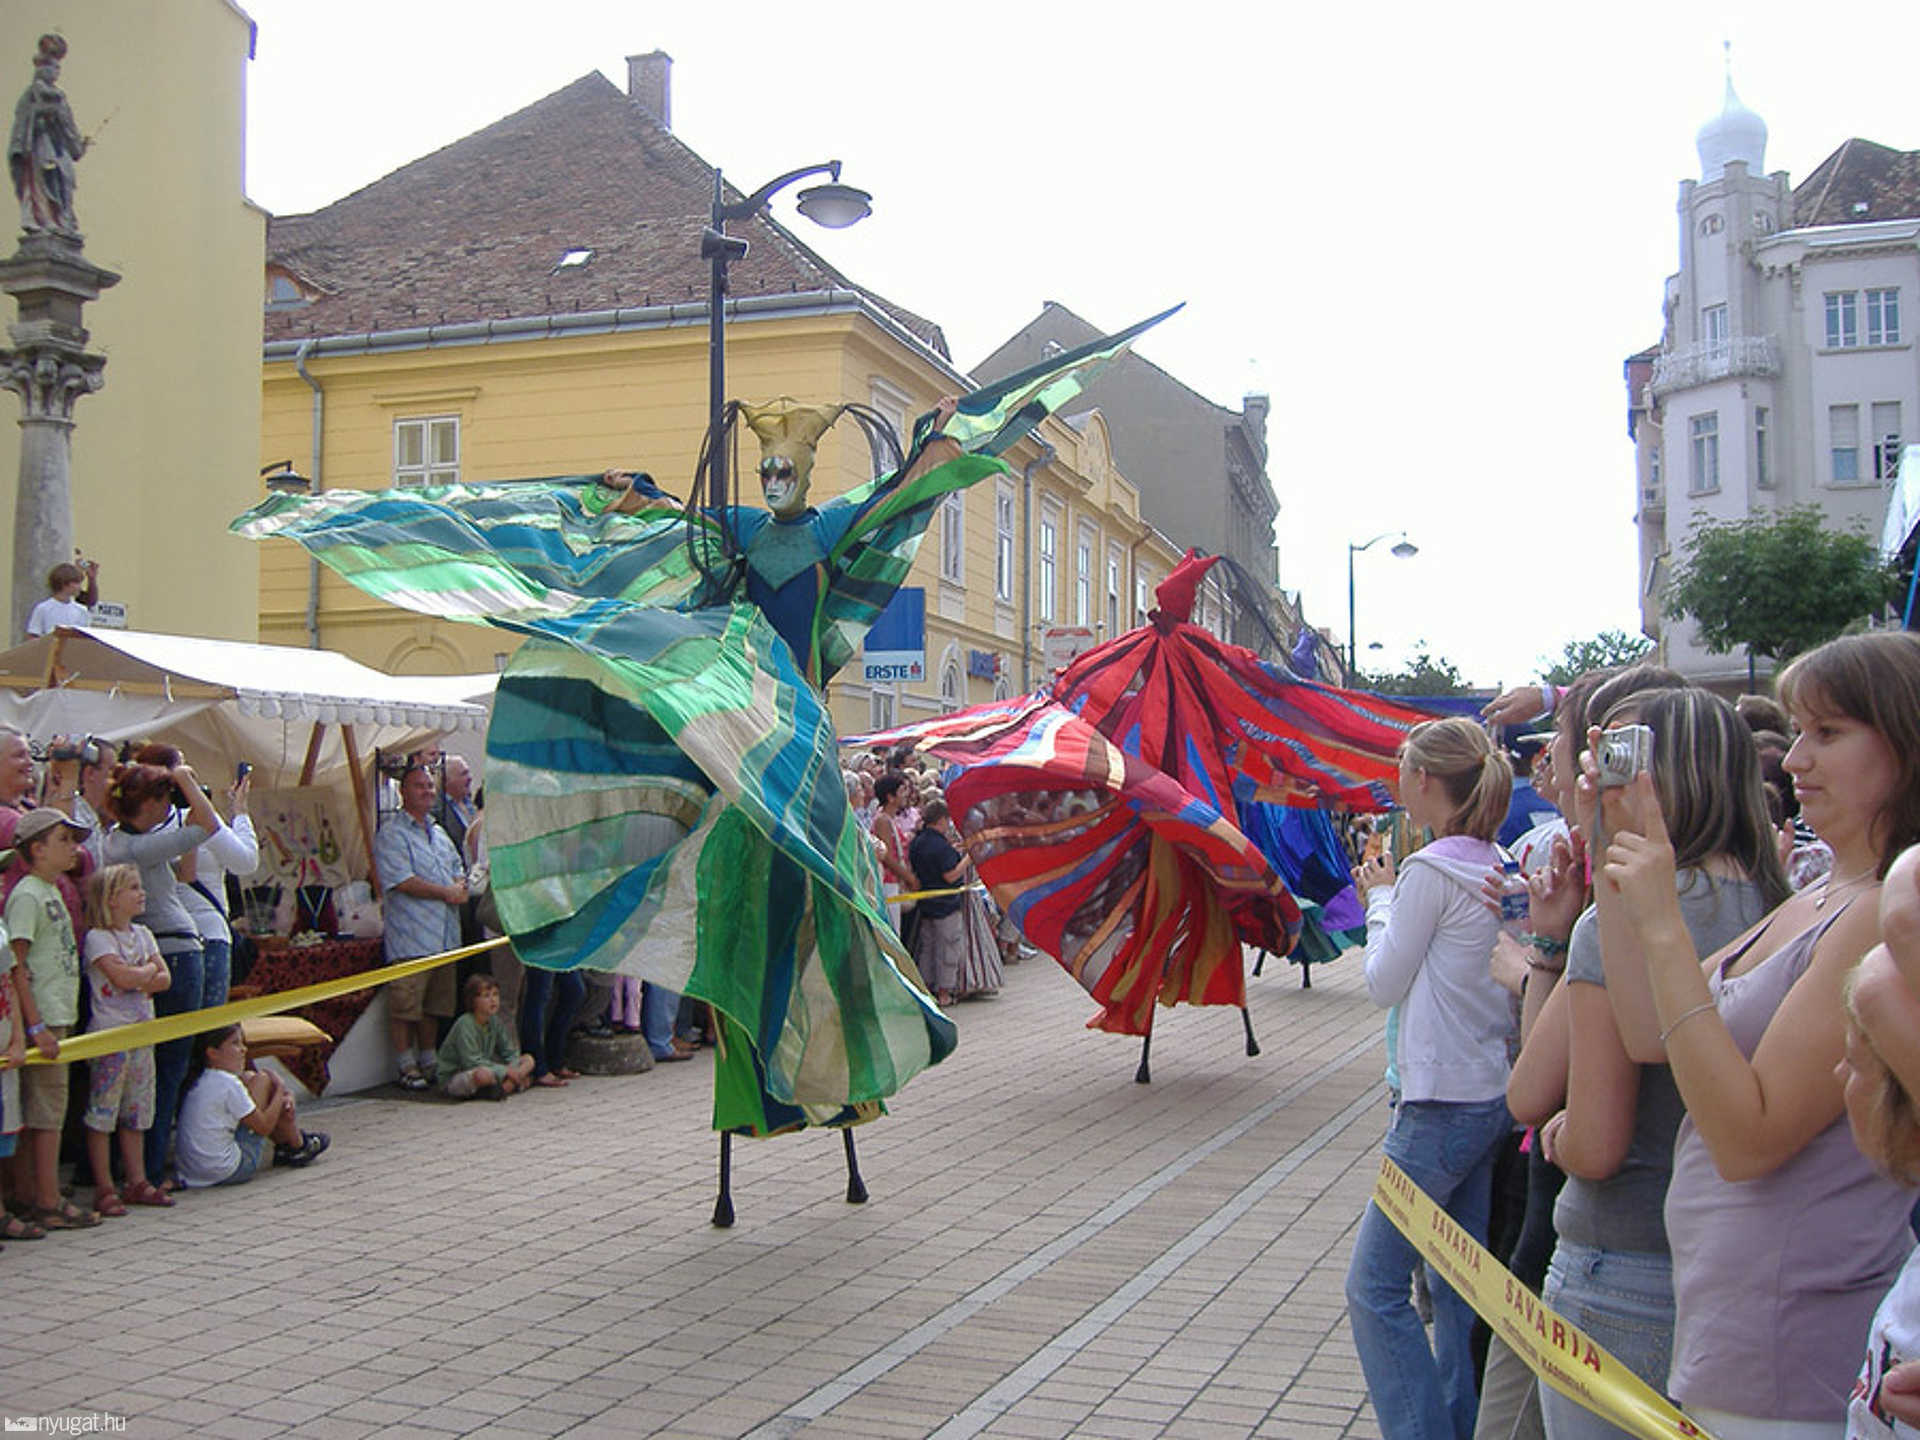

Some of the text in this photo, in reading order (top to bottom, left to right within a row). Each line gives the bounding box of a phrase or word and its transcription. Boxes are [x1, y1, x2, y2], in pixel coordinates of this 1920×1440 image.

[865, 664, 908, 679] ERSTE
[1432, 1210, 1481, 1273] SAVARIA
[1504, 1279, 1601, 1373] SAVARIA
